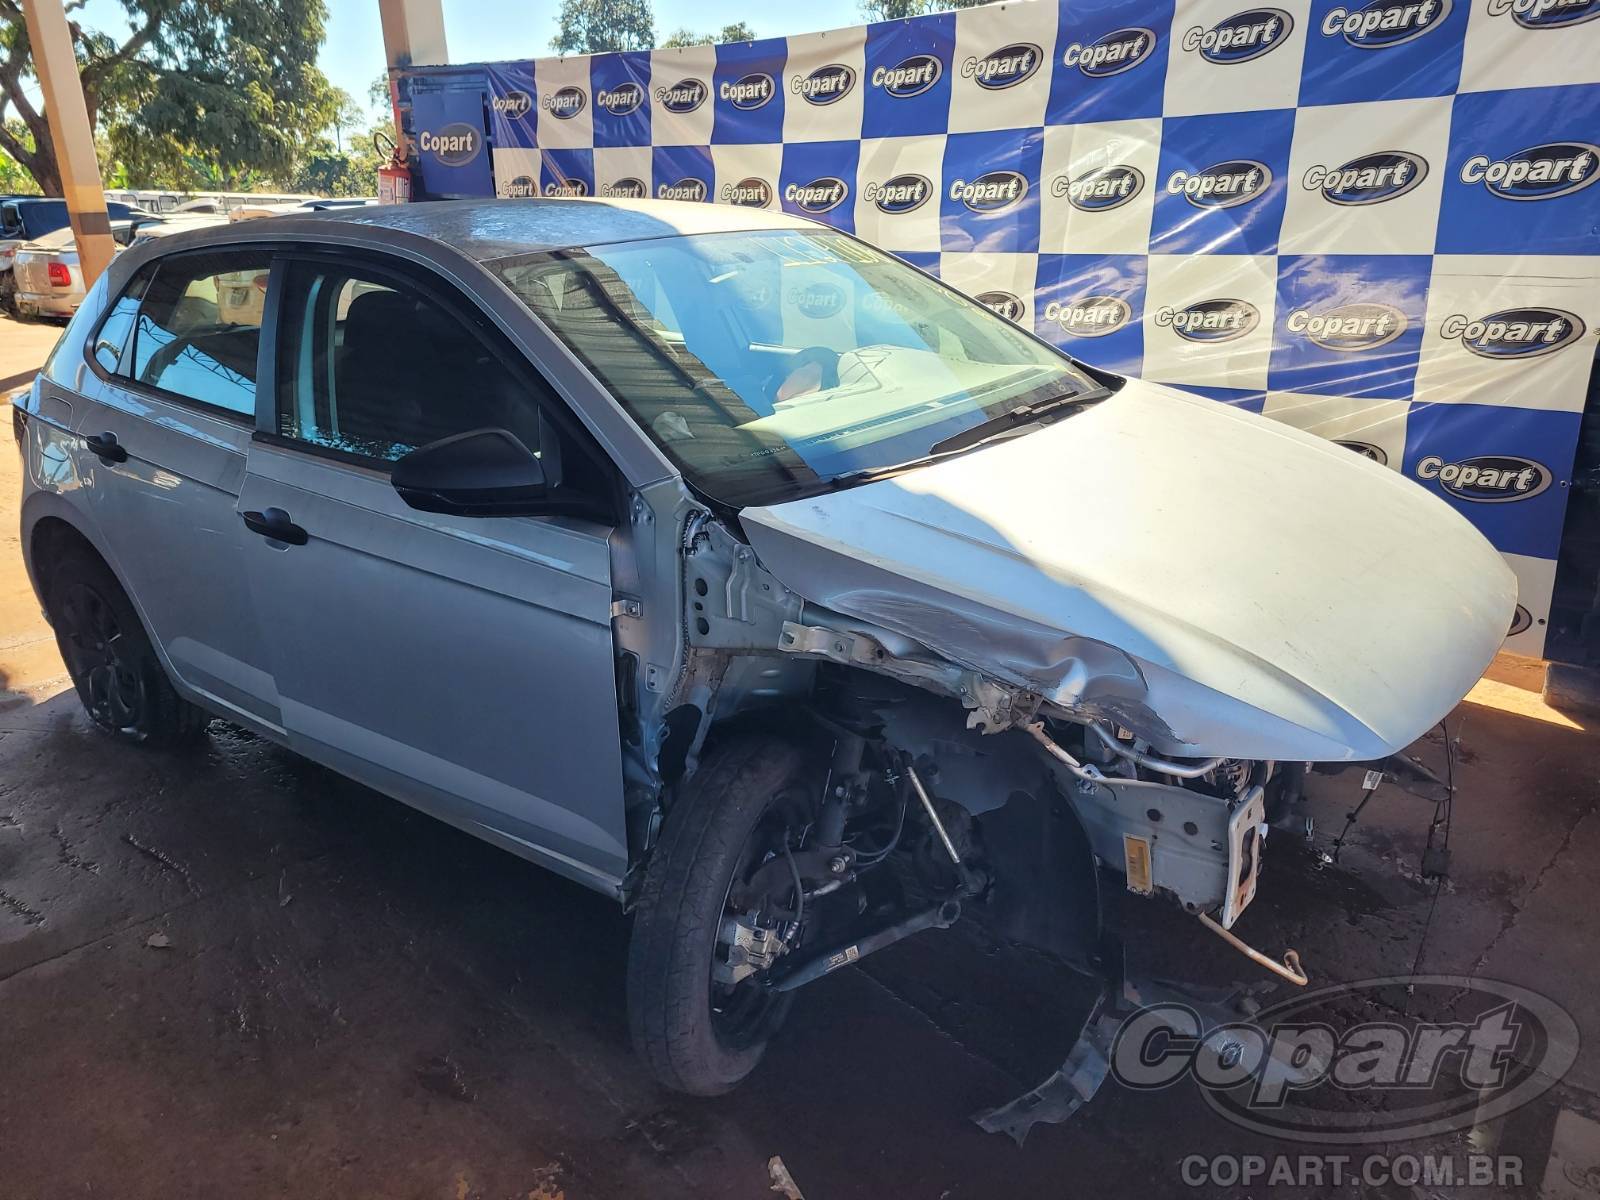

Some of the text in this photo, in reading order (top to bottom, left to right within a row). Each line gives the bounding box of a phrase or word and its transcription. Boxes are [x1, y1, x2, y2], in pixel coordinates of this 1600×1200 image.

[1321, 0, 1433, 38] Copart
[1182, 17, 1279, 55] Copart
[961, 49, 1031, 82] Copart
[1064, 35, 1144, 69] Copart
[791, 70, 846, 96] Copart
[872, 58, 934, 90] Copart
[492, 93, 526, 113] Copart
[542, 93, 580, 111] Copart
[598, 87, 640, 109] Copart
[655, 86, 700, 108] Copart
[720, 78, 767, 105] Copart
[421, 131, 473, 155] Copart
[1167, 167, 1259, 198] Copart
[1302, 157, 1409, 194] Copart
[1460, 149, 1590, 190] Copart
[721, 183, 767, 208] Copart
[785, 180, 842, 207] Copart
[865, 179, 924, 207] Copart
[950, 176, 1019, 208] Copart
[1051, 174, 1132, 208] Copart
[787, 287, 837, 308] Copart
[1044, 302, 1120, 332] Copart
[1155, 305, 1246, 332] Copart
[1286, 308, 1392, 337] Copart
[1440, 314, 1565, 346] Copart
[1416, 456, 1536, 490] Copart
